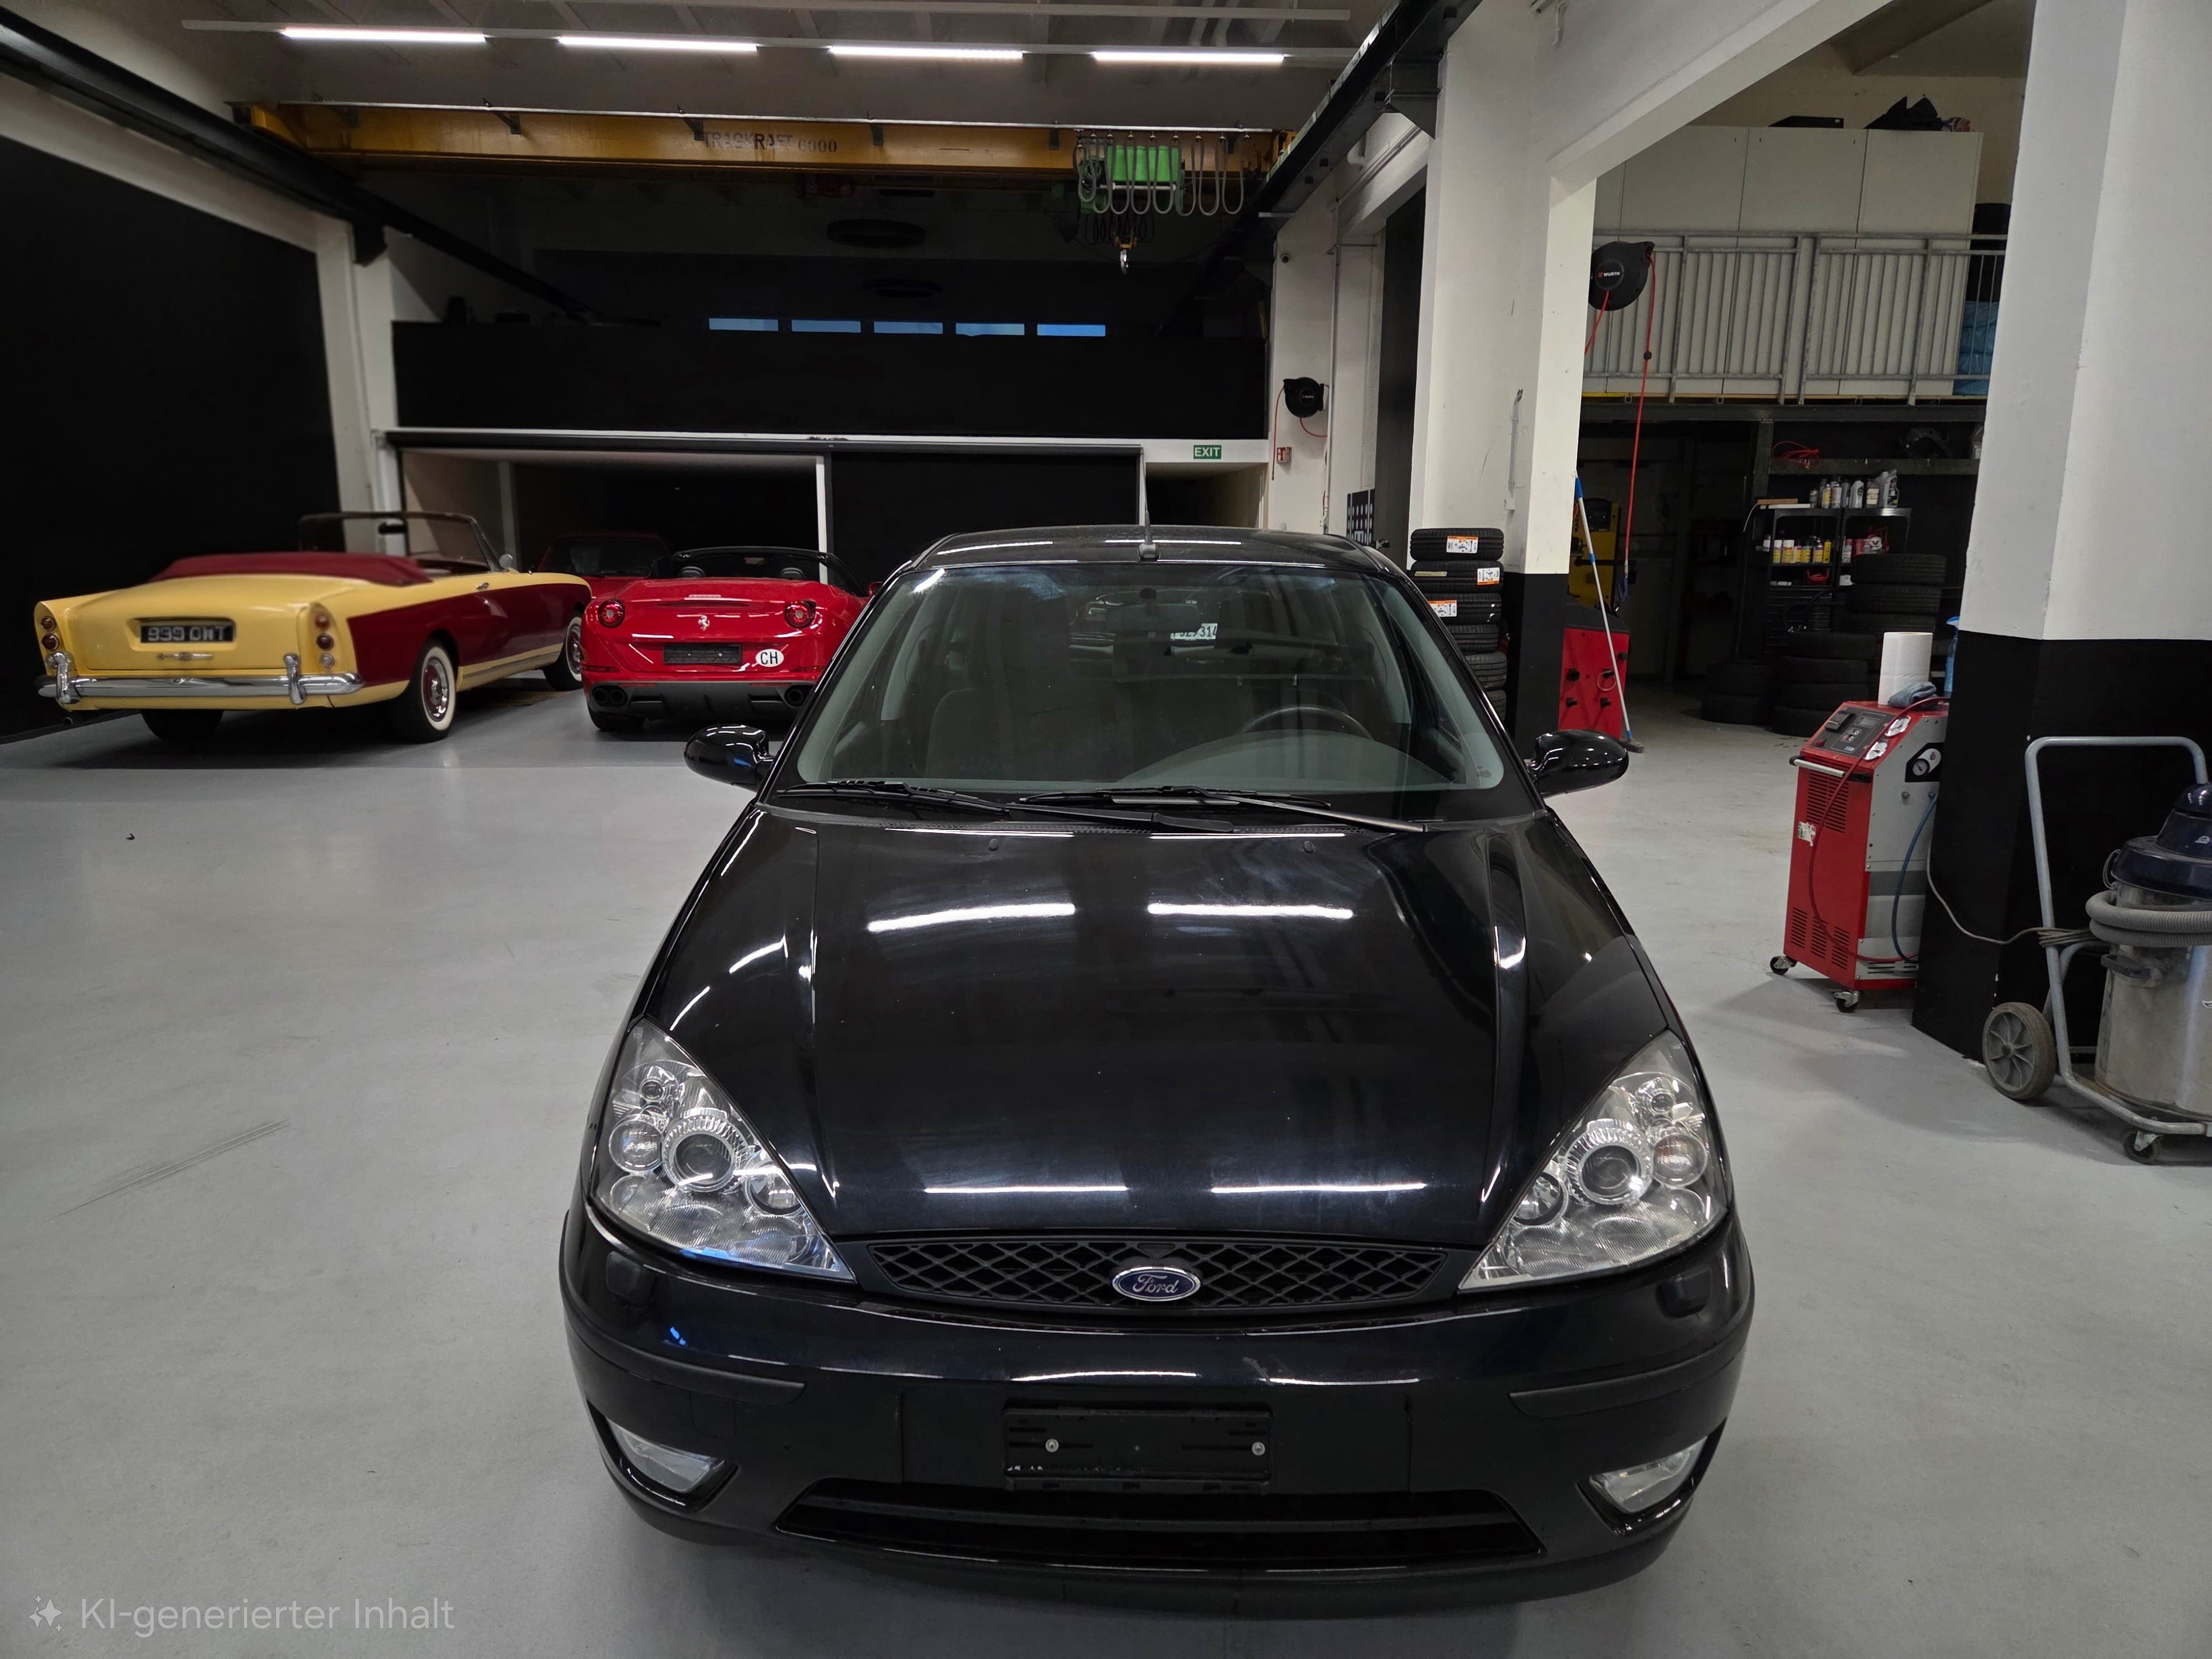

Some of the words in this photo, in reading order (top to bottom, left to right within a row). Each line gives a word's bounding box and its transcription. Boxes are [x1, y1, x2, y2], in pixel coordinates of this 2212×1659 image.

[798, 139, 838, 153] 6000
[1194, 447, 1220, 458] EXIT
[148, 626, 185, 641] 999
[761, 648, 778, 665] CH
[1132, 1274, 1180, 1294] Ford
